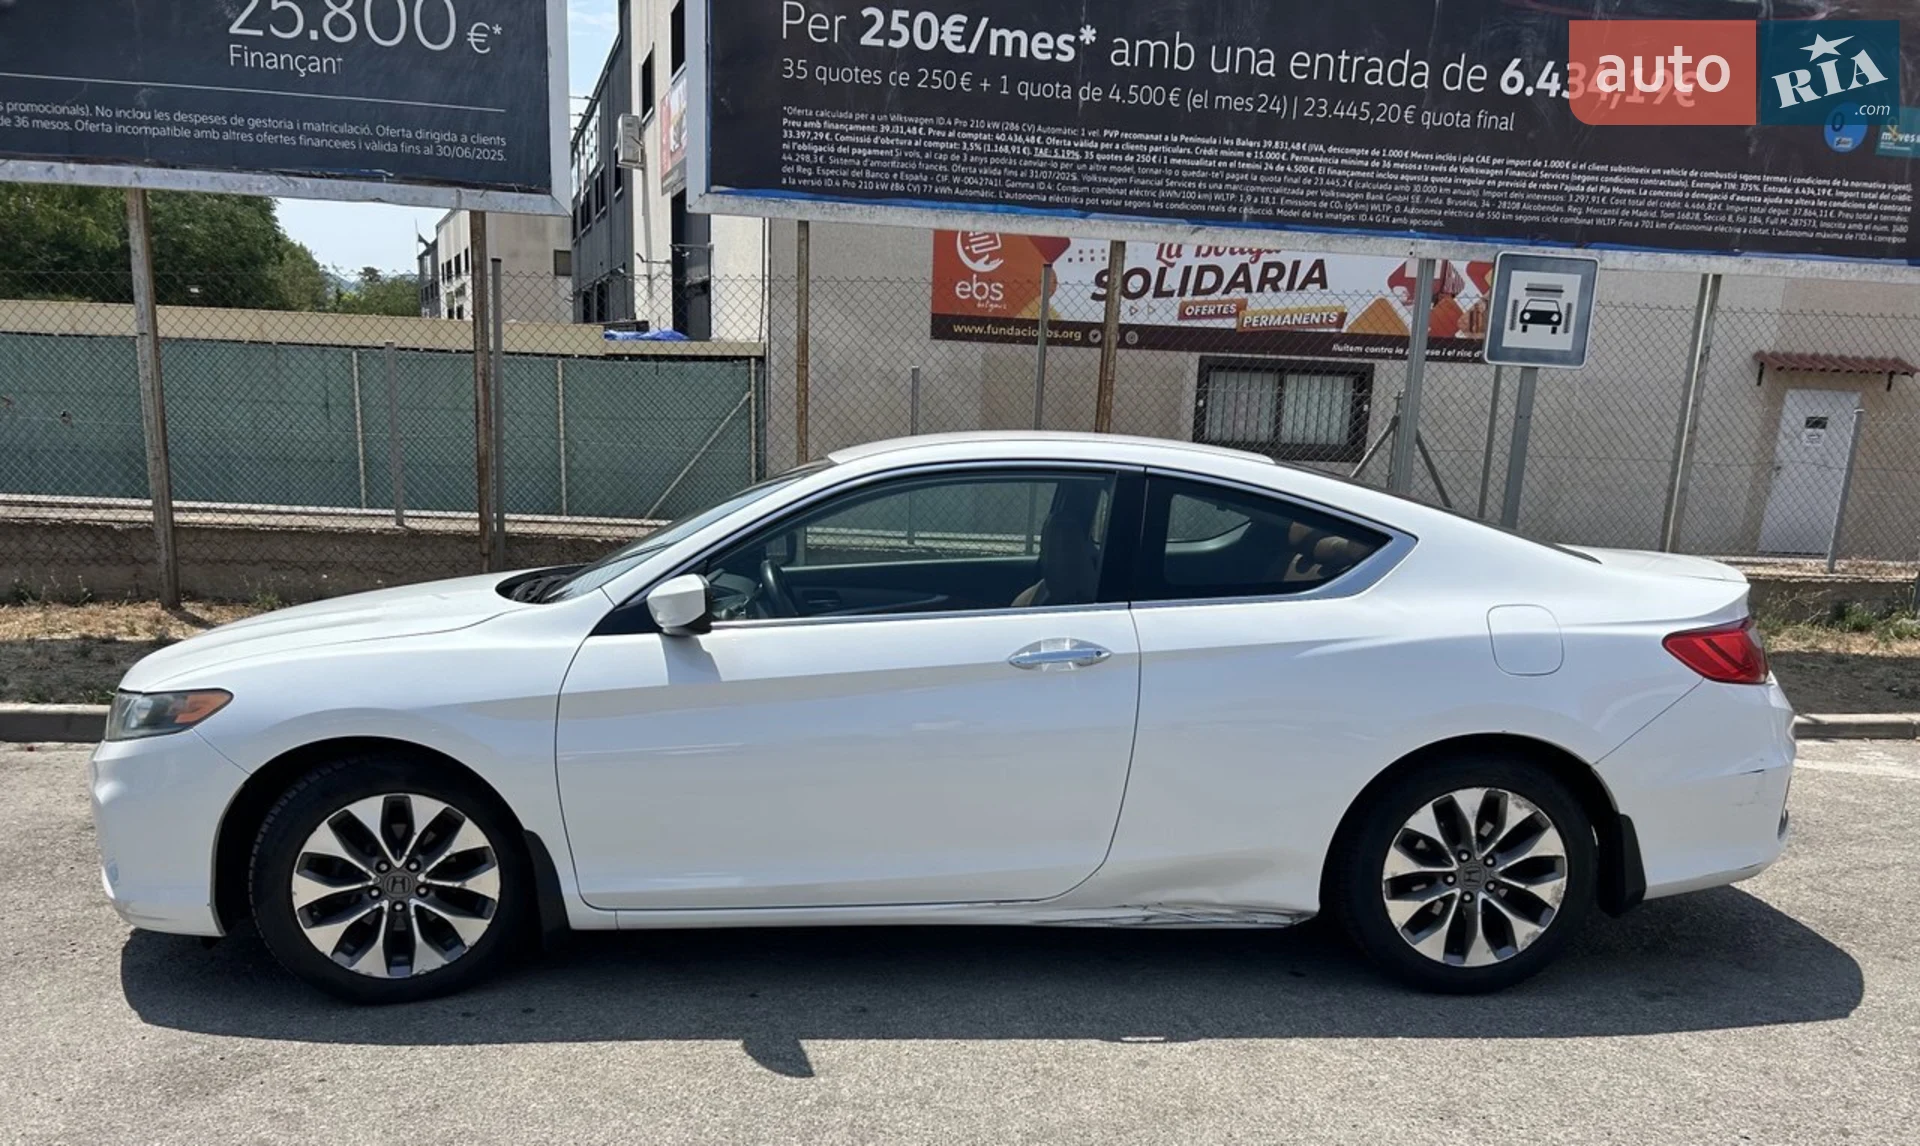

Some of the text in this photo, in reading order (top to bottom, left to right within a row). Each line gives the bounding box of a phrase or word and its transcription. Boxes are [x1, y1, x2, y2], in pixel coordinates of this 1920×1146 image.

[229, 0, 456, 51] 25.800
[782, 1, 847, 43] Per
[1111, 31, 1195, 72] amb
[1211, 44, 1274, 77] una
[1290, 48, 1429, 90] entrada
[1442, 53, 1487, 93] de
[782, 58, 808, 80] 35
[815, 65, 882, 86] quotes
[1000, 75, 1009, 94] 1
[1017, 79, 1072, 101] quota
[1078, 83, 1102, 102] de
[1187, 87, 1208, 113] (el
[1215, 94, 1253, 113] mes
[1257, 96, 1288, 119] 24)
[1421, 107, 1471, 131] quota
[1476, 109, 1516, 132] final
[6, 101, 92, 116] promocionals).
[115, 107, 151, 119] inclou
[153, 110, 170, 120] les
[173, 111, 227, 125] despeses
[246, 116, 294, 130] gestoria
[375, 125, 412, 137] Oferta
[414, 128, 458, 143] dirigida
[470, 133, 507, 145] clients
[31, 120, 72, 129] mesos.
[74, 120, 113, 131] Oferta
[115, 122, 191, 139] incompatible
[192, 127, 220, 138] amb
[221, 129, 254, 141] altres
[255, 131, 296, 143] ofertes
[364, 139, 398, 151] vàlida
[400, 142, 420, 153] fins
[435, 145, 507, 162] 30/06/2025.
[782, 116, 801, 126] Preu
[802, 118, 821, 128] amb
[927, 126, 945, 136] Preu
[1044, 135, 1071, 145] Oferta
[1099, 141, 1113, 151] per
[953, 116, 967, 126] Pro
[969, 118, 986, 127] 210
[1103, 127, 1119, 137] PVP
[1120, 129, 1162, 141] recomanat
[1475, 154, 1490, 163] CAE
[955, 273, 1004, 301] ebs
[1090, 258, 1329, 301] SOLIDARIA
[1185, 303, 1237, 317] OFERTES
[1242, 311, 1338, 328] PERMANENTS
[953, 323, 1082, 341] www.fundaciobs.org
